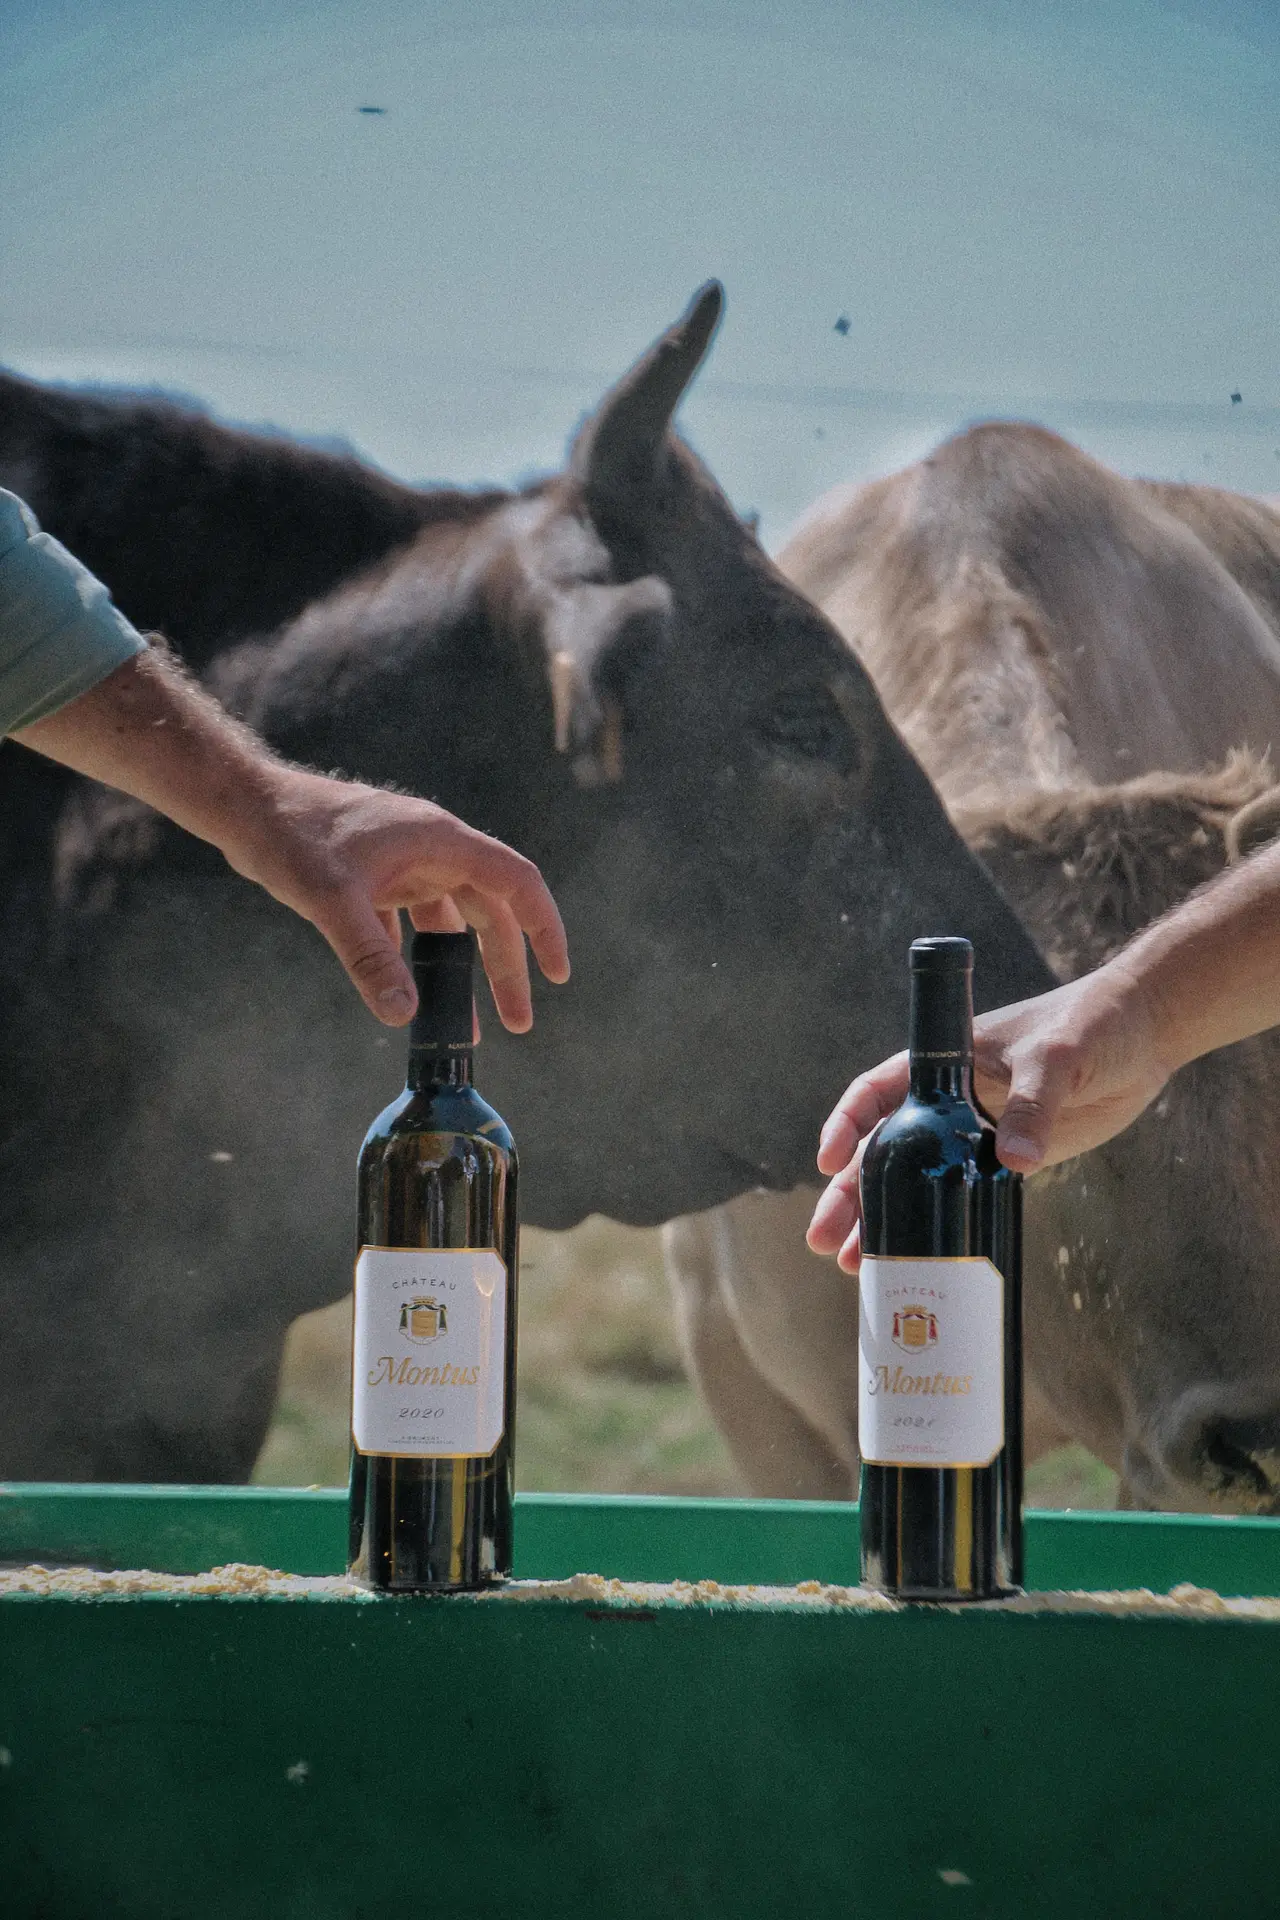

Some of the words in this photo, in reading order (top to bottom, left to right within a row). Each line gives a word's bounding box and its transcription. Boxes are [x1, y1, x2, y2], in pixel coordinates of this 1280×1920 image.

[368, 1356, 480, 1386] Montus
[868, 1365, 973, 1396] Montus
[399, 1407, 445, 1419] 2020
